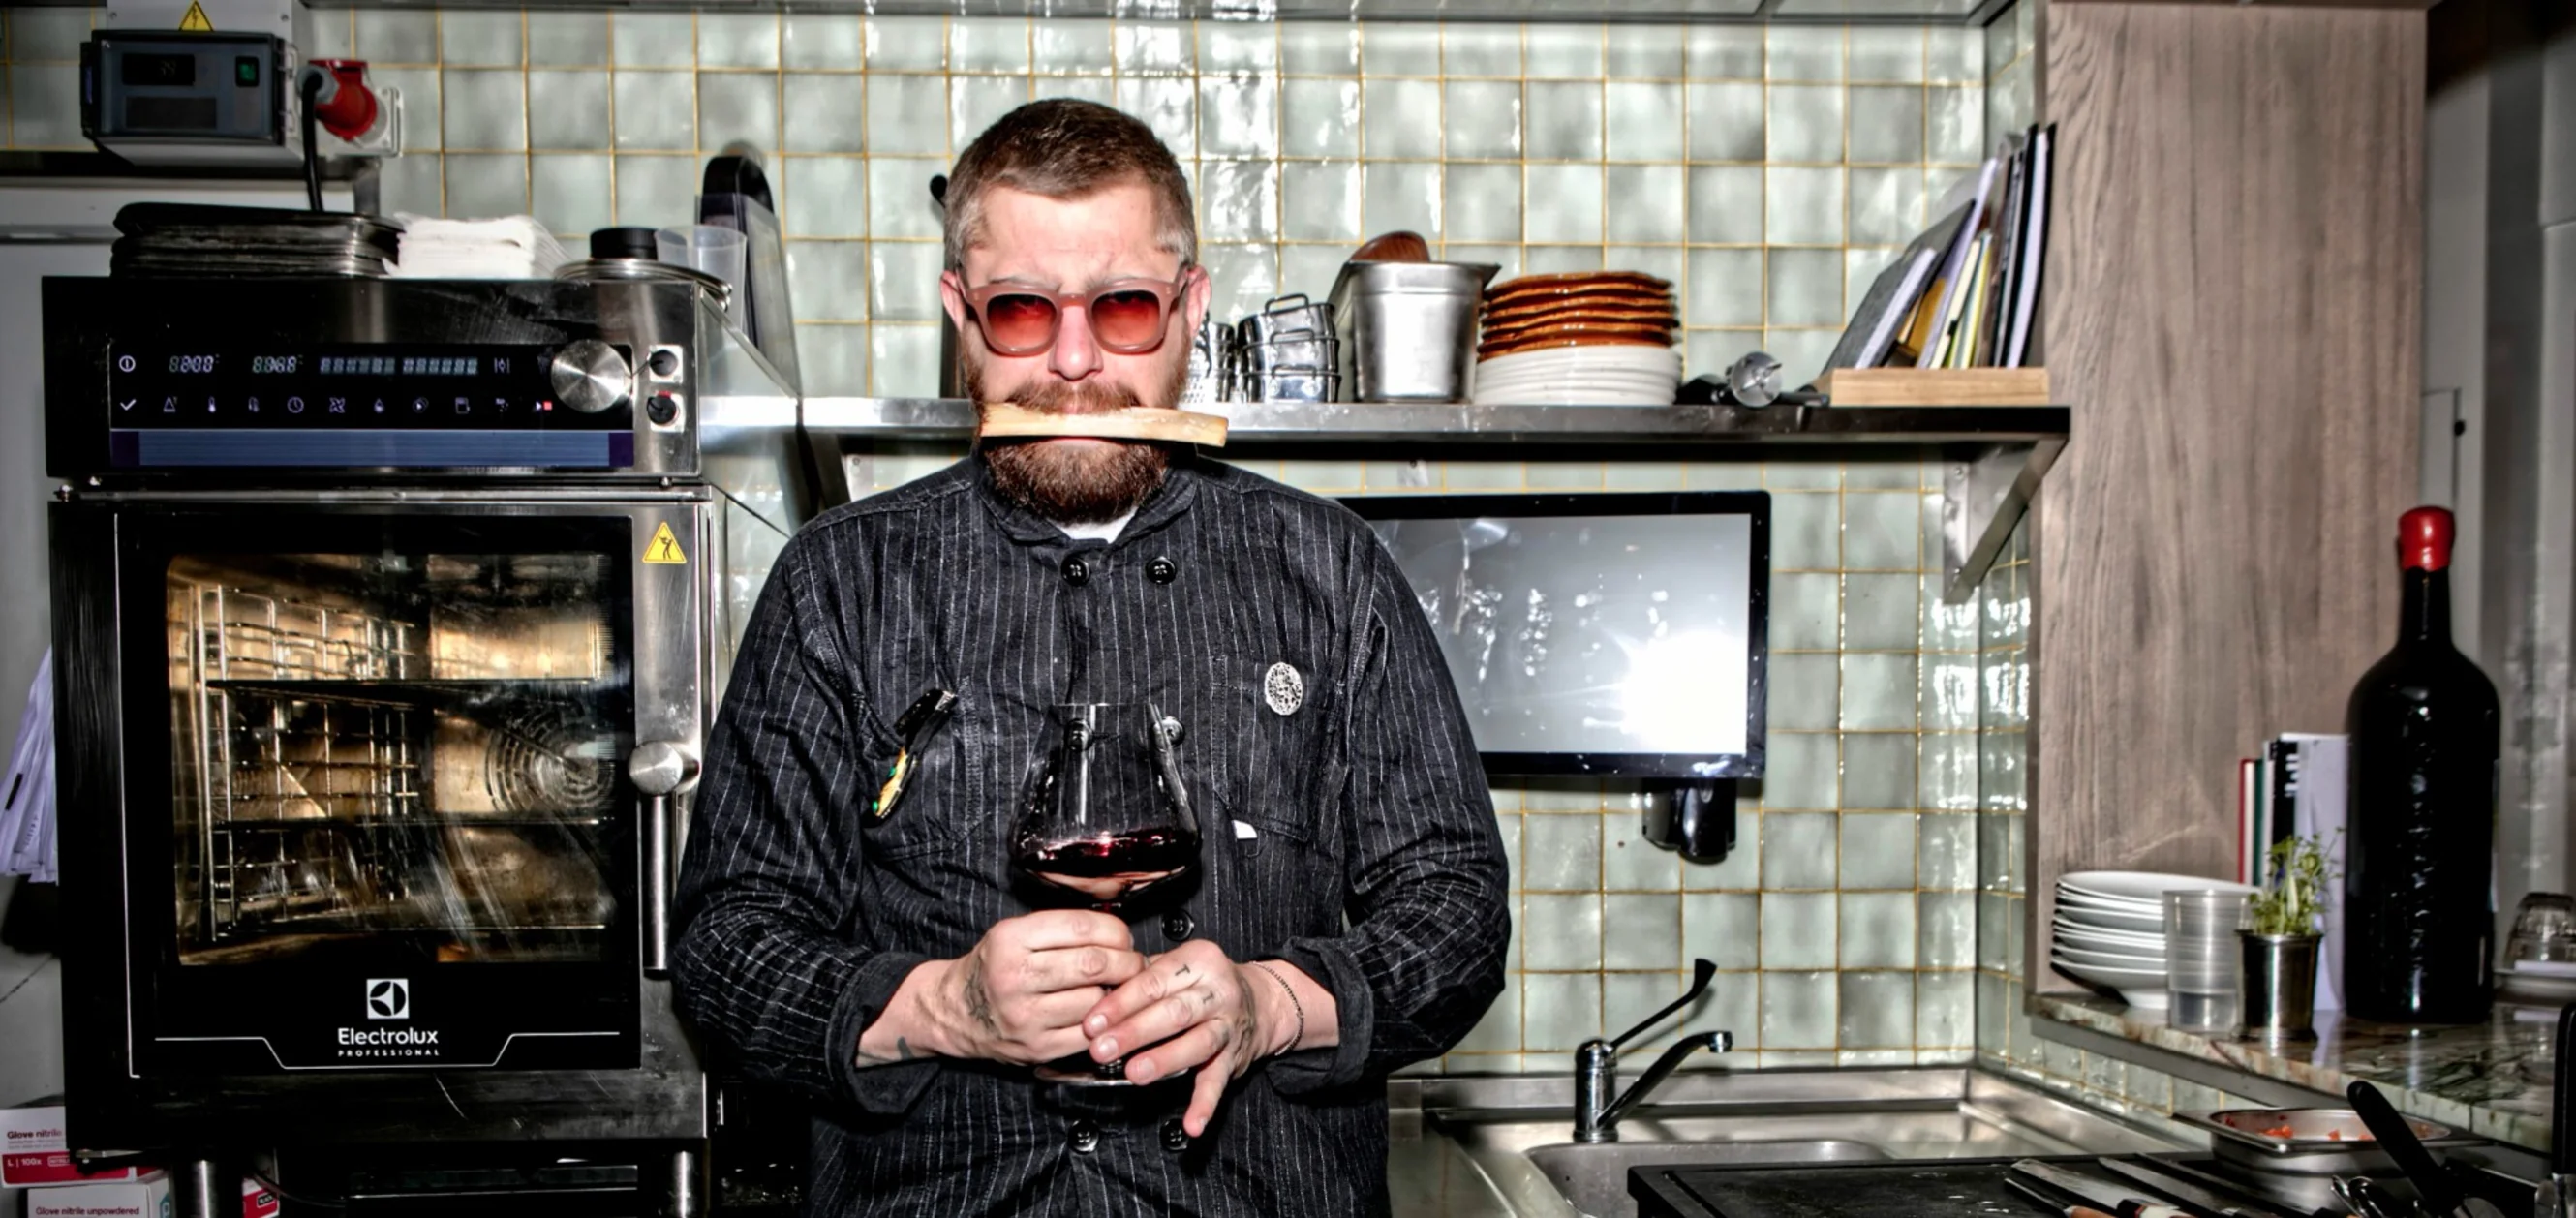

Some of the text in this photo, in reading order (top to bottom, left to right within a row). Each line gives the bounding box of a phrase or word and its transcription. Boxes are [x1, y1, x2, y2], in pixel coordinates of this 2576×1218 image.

[338, 1027, 439, 1045] Electrolux
[338, 1049, 439, 1057] PROFESSIONAL
[7, 1131, 34, 1140] Glove
[21, 1158, 42, 1167] 100x
[87, 1207, 139, 1216] unpowdered
